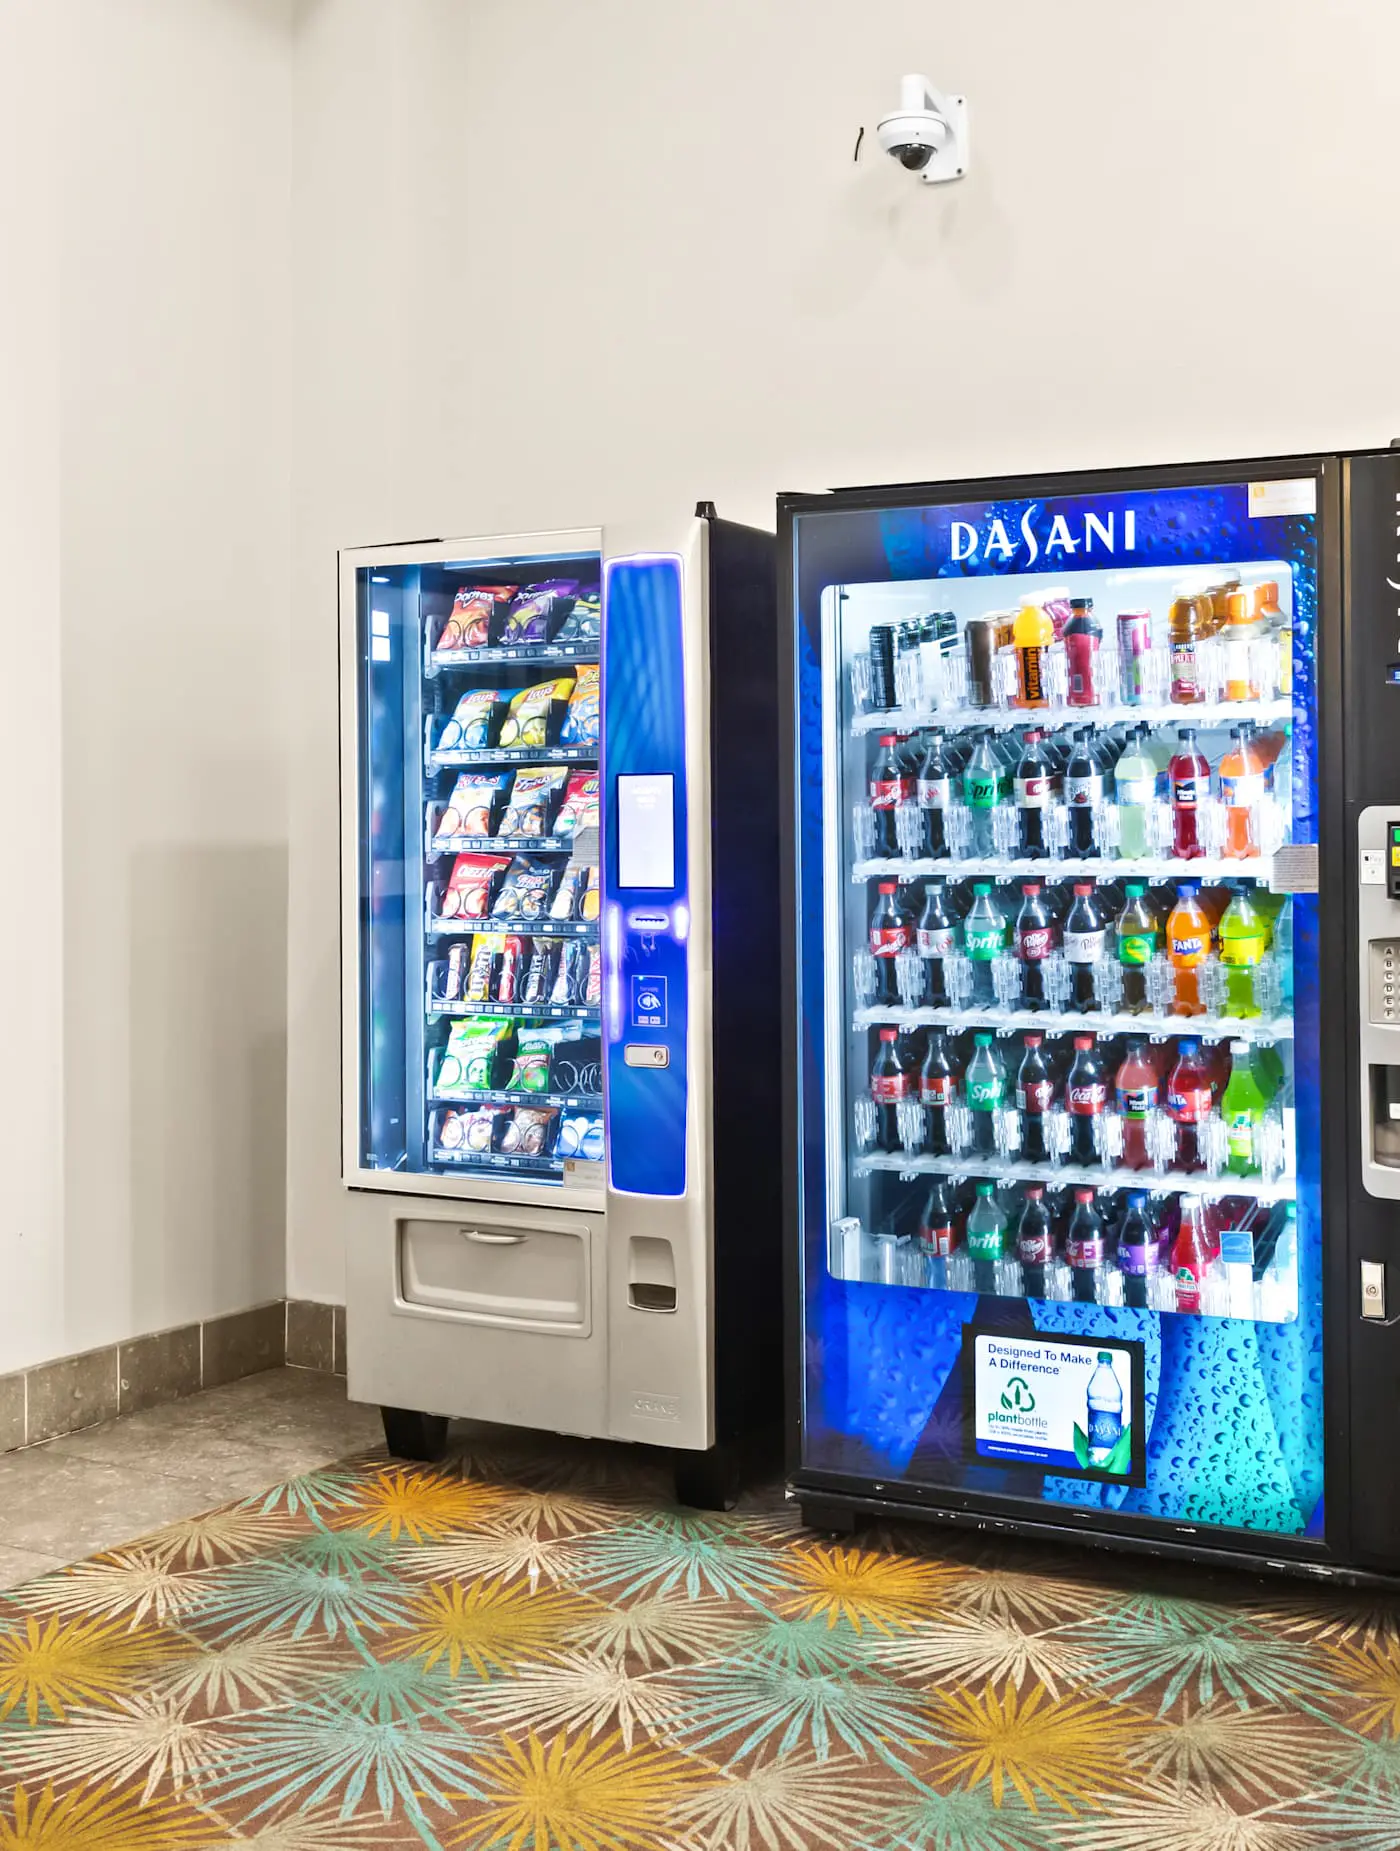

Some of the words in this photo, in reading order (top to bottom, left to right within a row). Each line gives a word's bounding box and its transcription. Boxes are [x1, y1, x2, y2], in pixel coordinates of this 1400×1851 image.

[951, 504, 1135, 567] DASANI
[1028, 647, 1041, 699] vitamin
[1386, 972, 1392, 980] C
[1386, 997, 1393, 1005] E
[1386, 1009, 1393, 1017] F
[988, 1343, 1041, 1359] Designed
[1044, 1350, 1057, 1361] To
[1060, 1352, 1092, 1365] Make
[989, 1358, 997, 1367] A
[1000, 1359, 1060, 1375] Difference
[988, 1411, 1048, 1429] plantbottle
